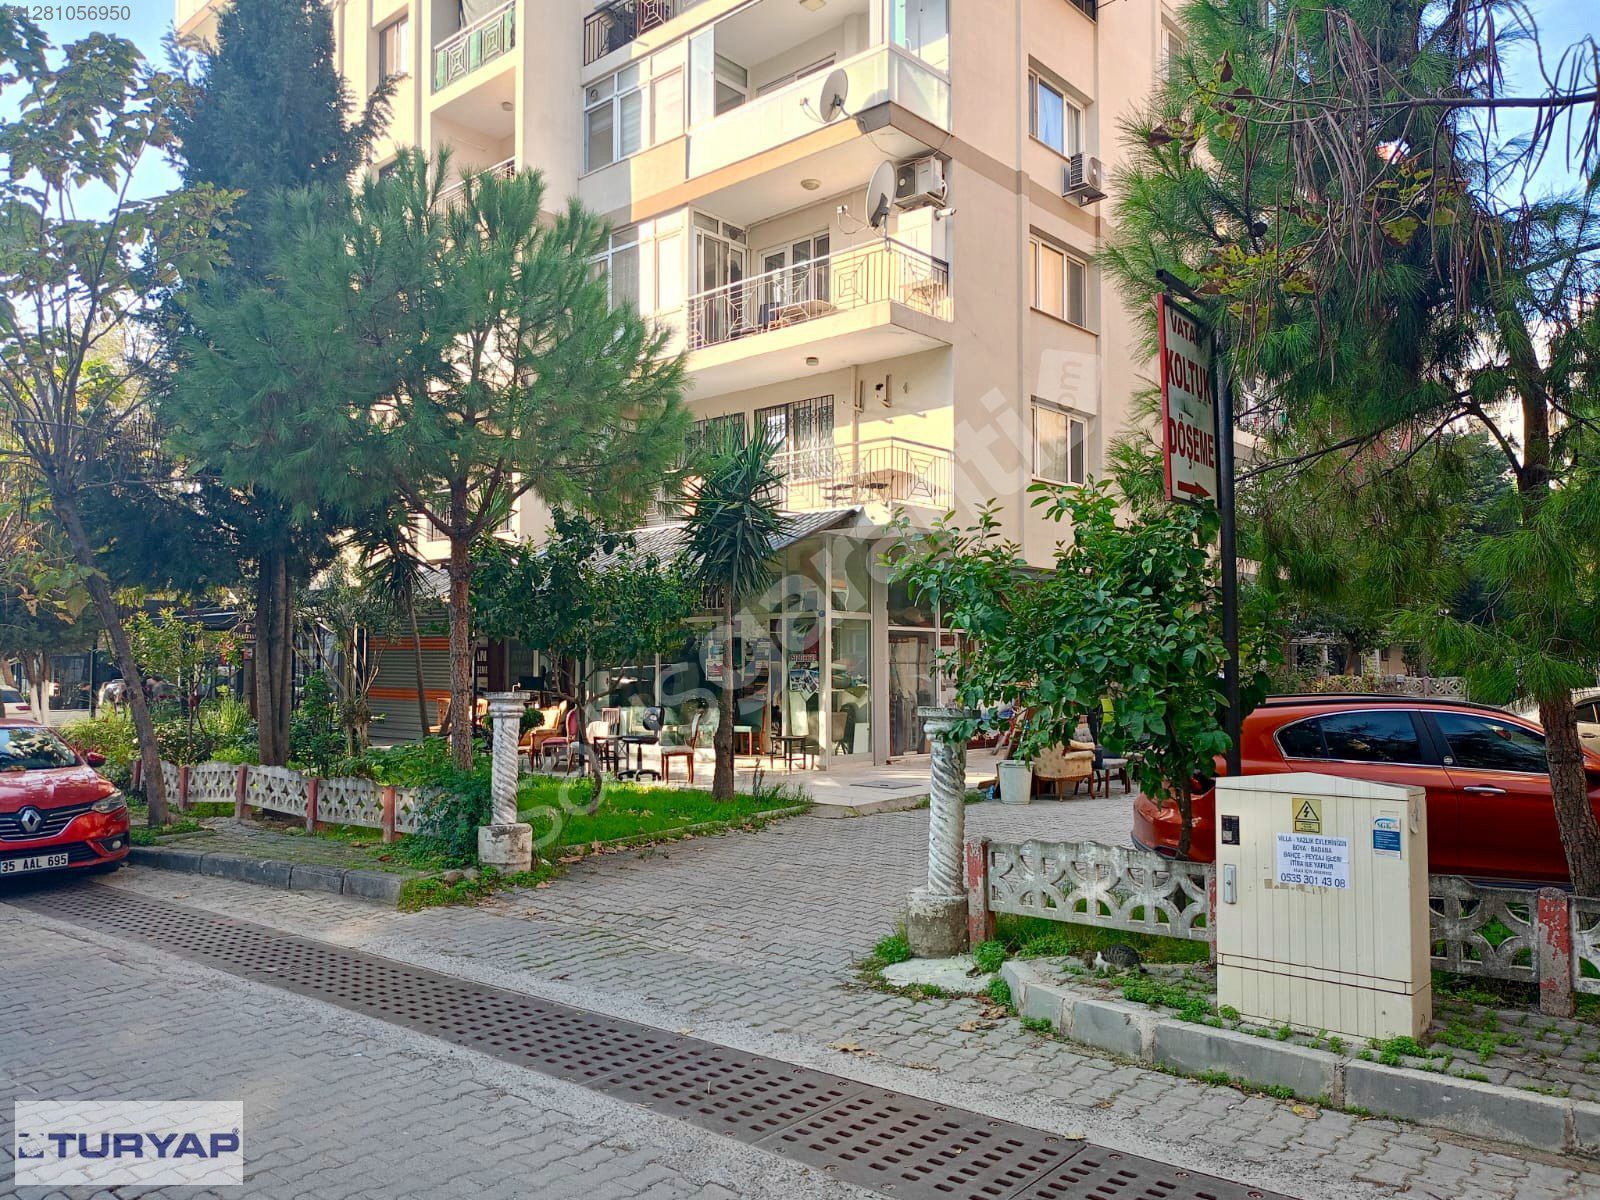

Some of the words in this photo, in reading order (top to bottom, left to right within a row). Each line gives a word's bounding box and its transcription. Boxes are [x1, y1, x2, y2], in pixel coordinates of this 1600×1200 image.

[1166, 348, 1212, 404] KOLTUK
[1168, 413, 1215, 469] DÖŞEME
[2, 861, 15, 872] 35
[23, 858, 42, 869] AAL
[47, 855, 66, 866] 695
[1280, 873, 1301, 883] 0535
[1303, 875, 1318, 885] 301
[1321, 877, 1333, 886] 43
[1334, 878, 1346, 888] 08
